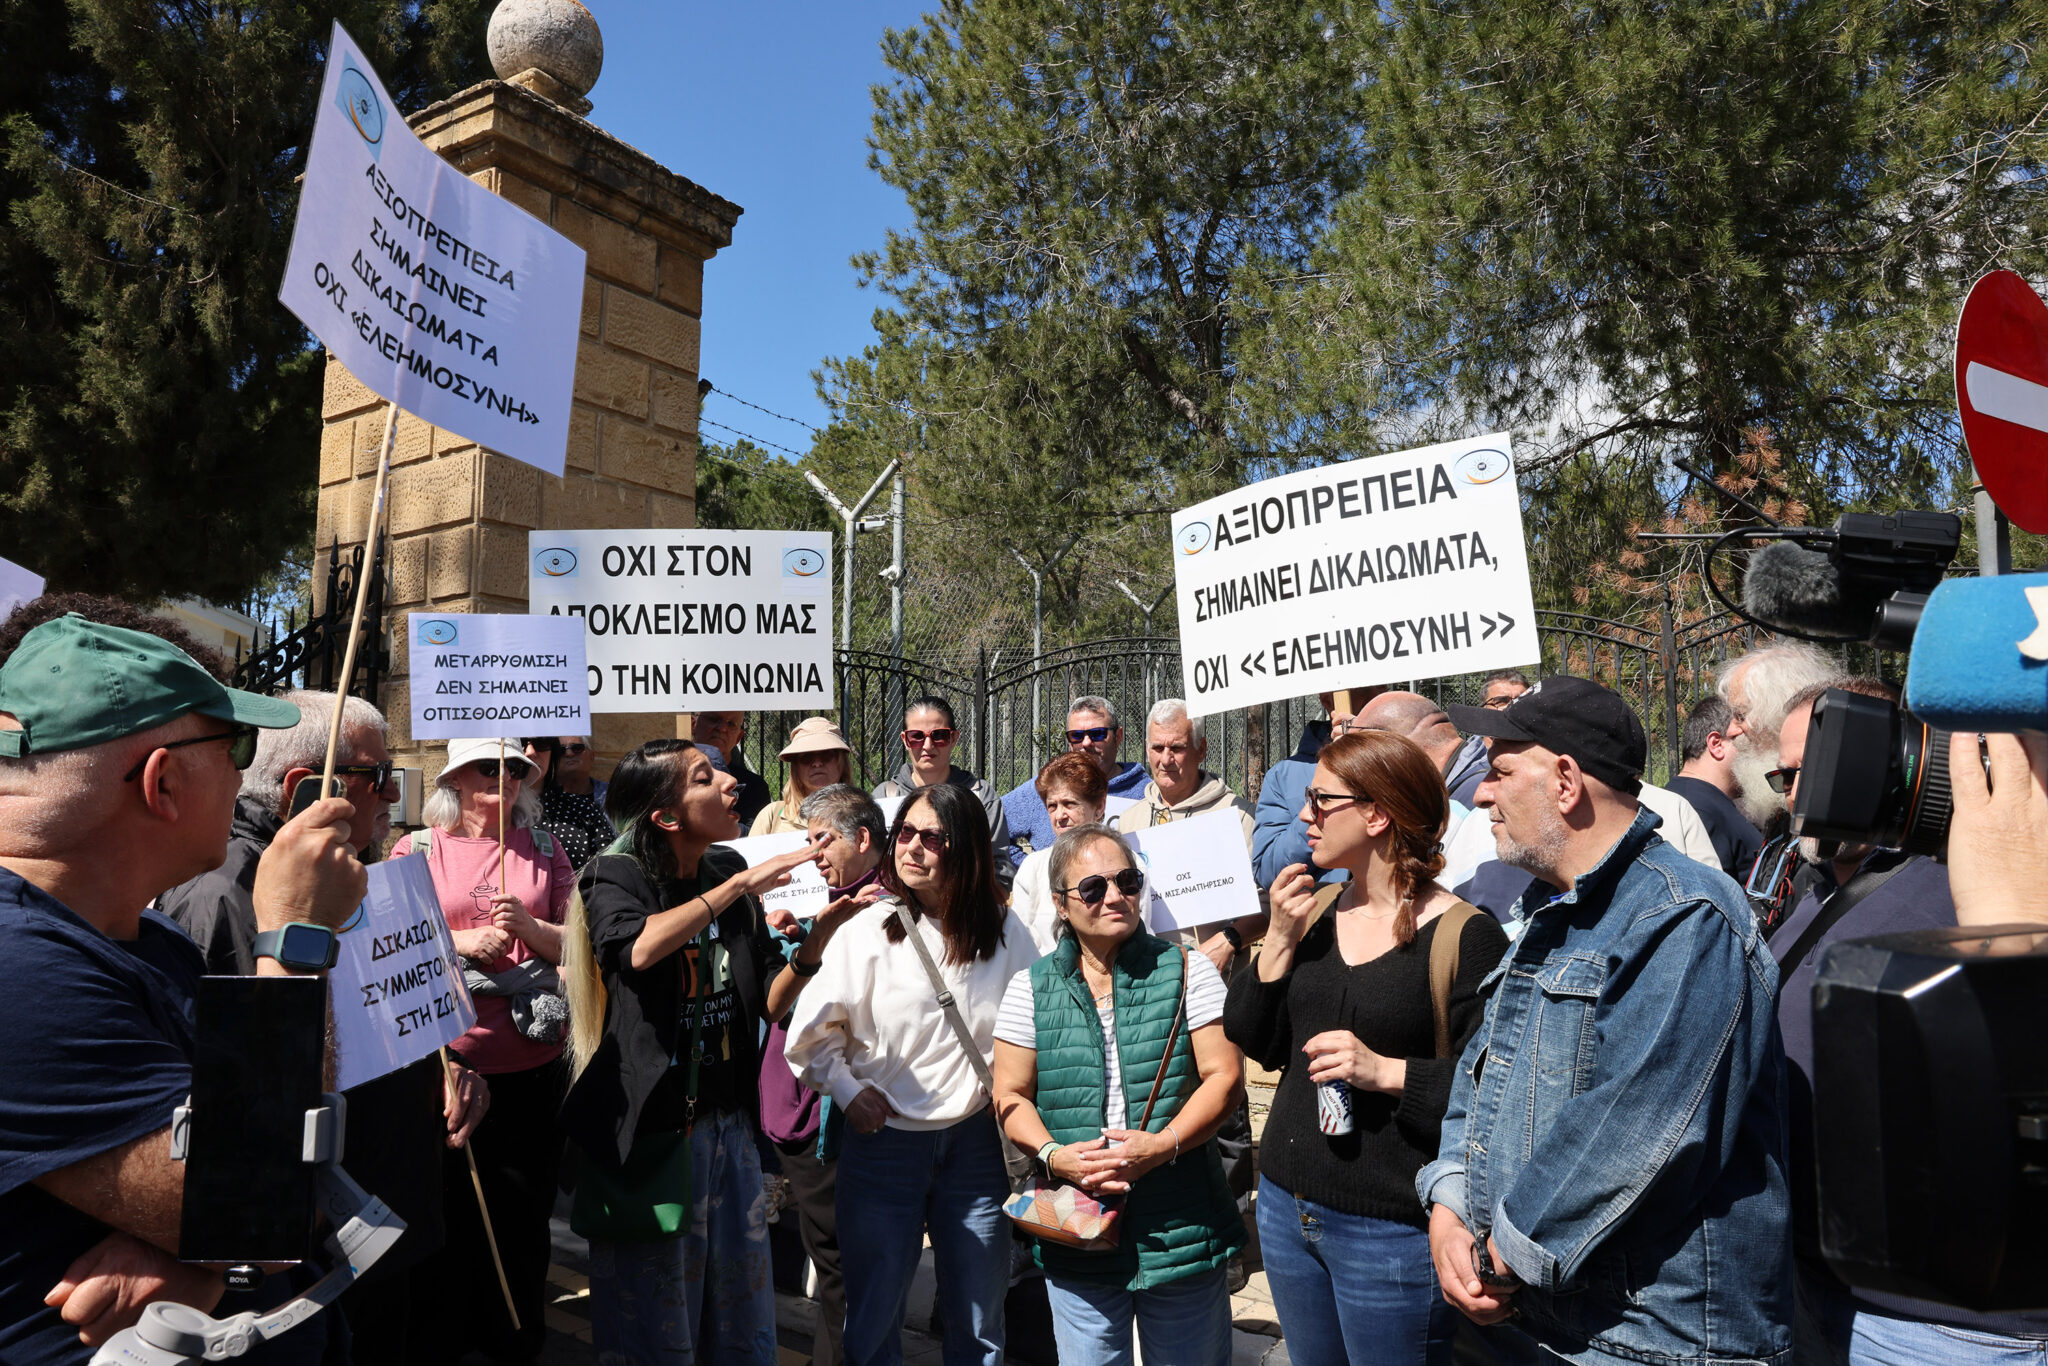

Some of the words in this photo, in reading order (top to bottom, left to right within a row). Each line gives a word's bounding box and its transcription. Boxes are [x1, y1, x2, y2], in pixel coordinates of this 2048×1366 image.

[366, 163, 515, 291] ΑΞΙΟΠΡΕΠΕΙΑ
[370, 217, 487, 317] ΣΗΜΑΙΝΕΙ
[314, 262, 347, 313] ΟΧΙ
[352, 249, 498, 366] ΔΙΚΑΙΩΜΑΤΑ
[1214, 463, 1457, 552] ΑΞΙΟΠΡΕΠΕΙΑ
[602, 545, 656, 577] ΟΧΙ
[668, 545, 751, 577] ΣΤΟΝ
[1194, 563, 1302, 623] ΣΗΜΑΙΝΕΙ
[1309, 531, 1498, 595] ΔΙΚΑΙΩΜΑΤΑ,
[756, 604, 817, 634] ΜΑΣ
[434, 654, 568, 669] ΜΕΤΑΡΡΥΘΜΙΣΗ
[1194, 655, 1229, 694] ΟΧΙ
[435, 680, 472, 695] ΔΕΝ
[479, 680, 569, 694] ΣΗΜΑΙΝΕΙ
[612, 665, 671, 696] ΤΗΝ
[683, 663, 824, 695] ΚΟΙΝΩΝΙΑ
[423, 705, 581, 722] ΟΠΙΣΘΟΔΡΟΜΗΣΗ
[1165, 877, 1234, 899] ΜΙΣΑΝΑΠΗΡΙΣΜΟ
[1175, 872, 1192, 881] ΟΧΙ
[395, 1004, 433, 1037] ΣΤΗ
[229, 1276, 249, 1284] BOYA
